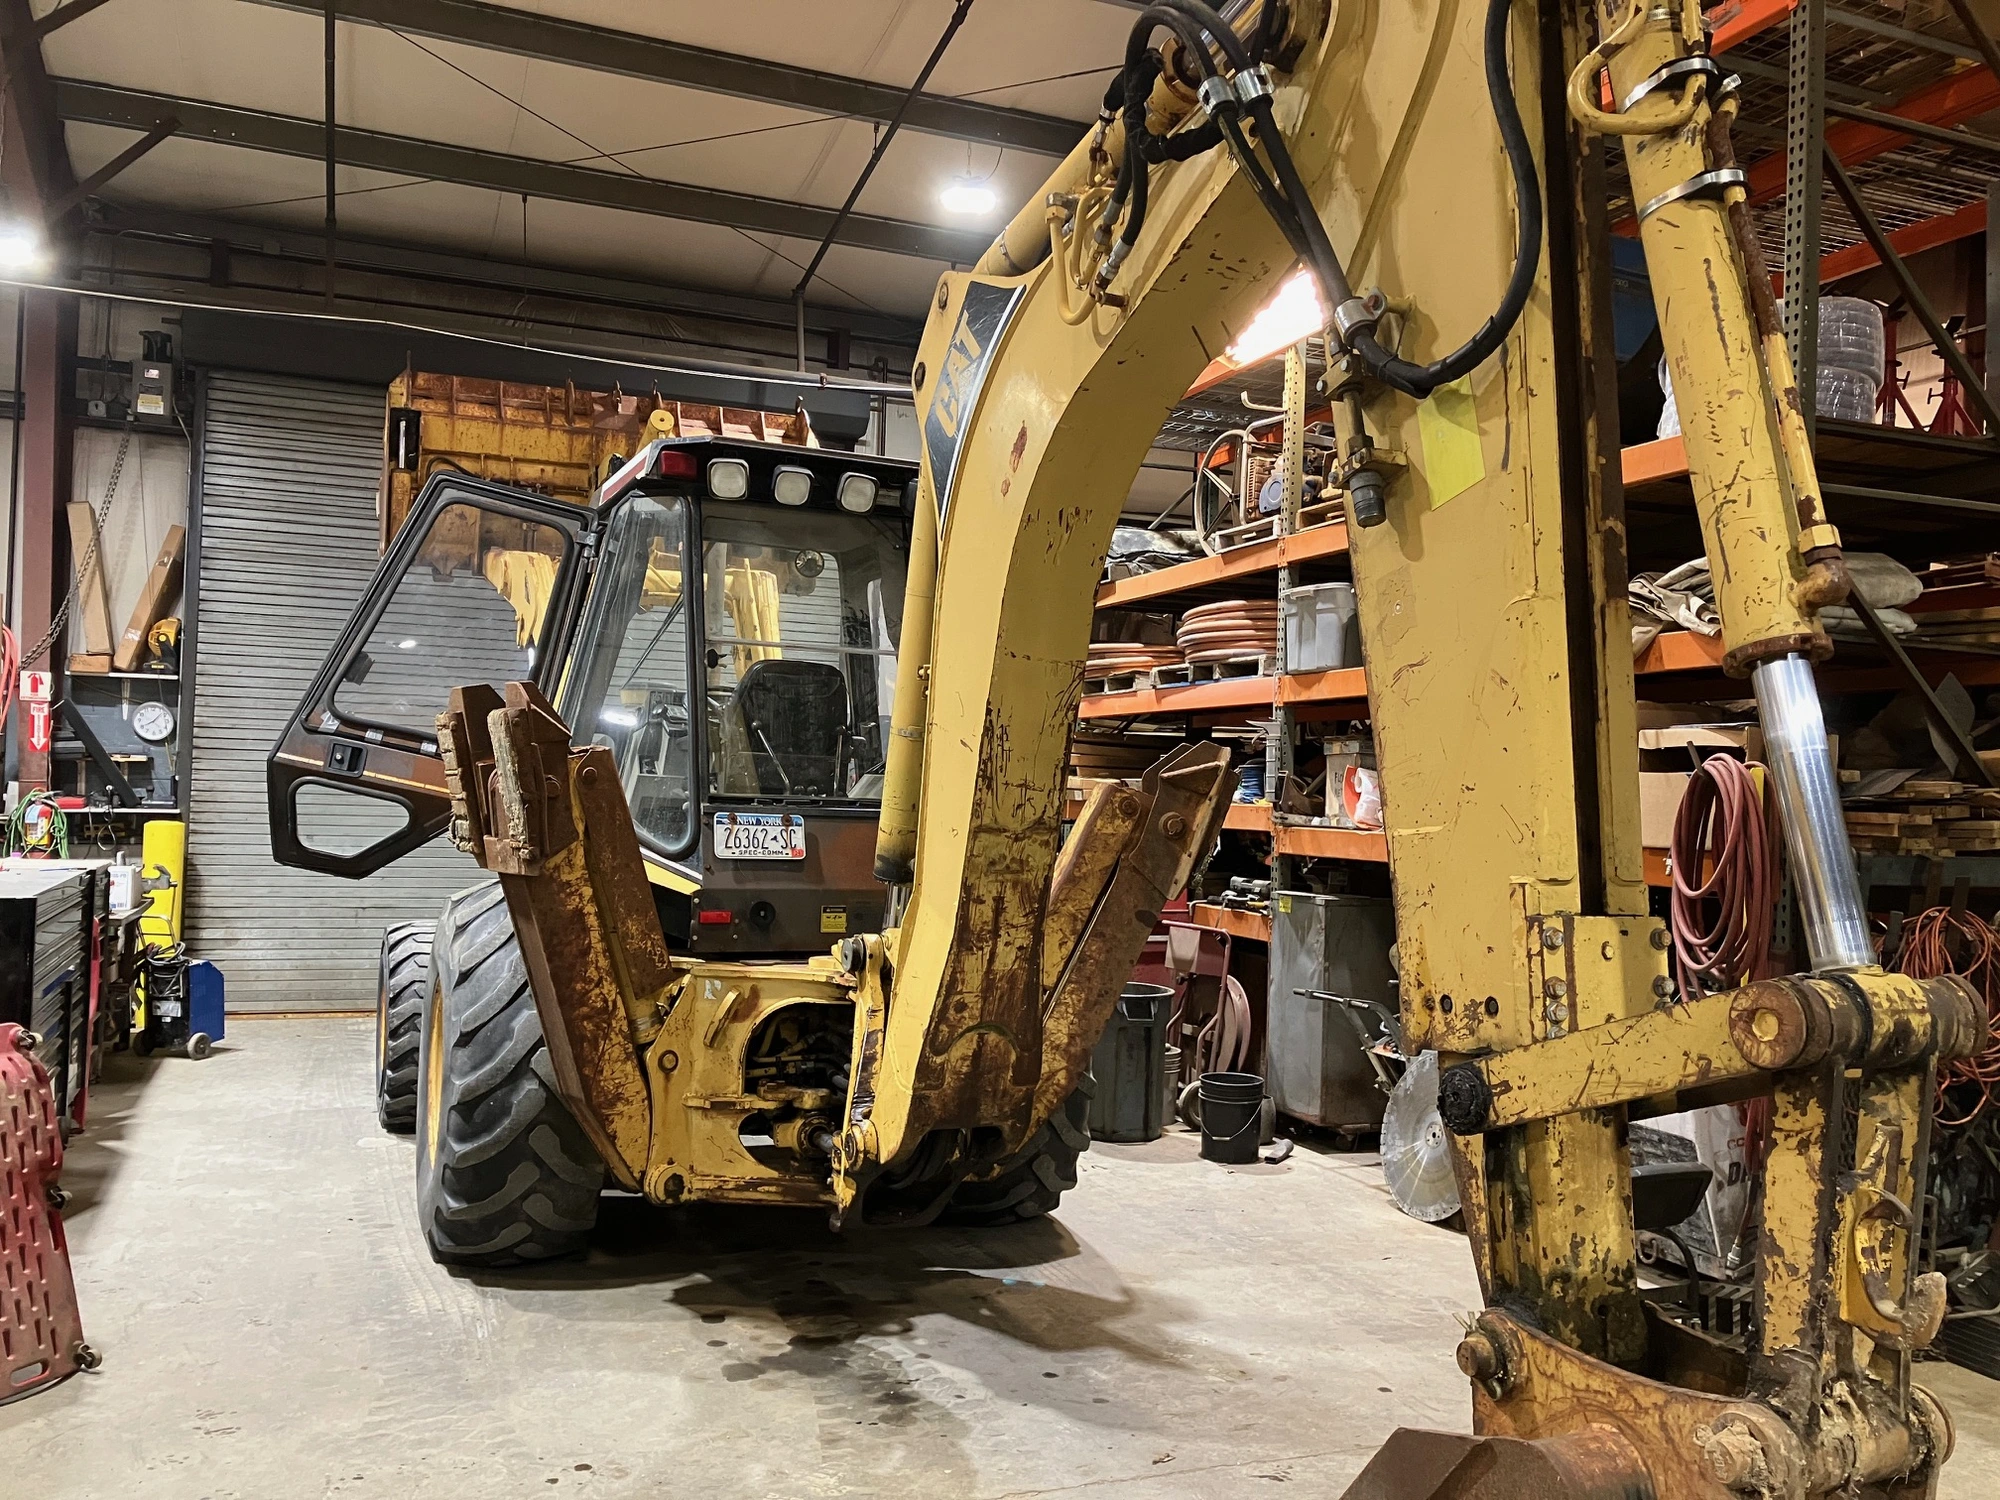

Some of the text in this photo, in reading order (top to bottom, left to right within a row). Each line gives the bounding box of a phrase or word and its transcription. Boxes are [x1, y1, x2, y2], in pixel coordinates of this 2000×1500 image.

[935, 309, 982, 438] CAT
[32, 706, 45, 714] FIRE
[737, 816, 782, 826] NEW YORK
[724, 827, 797, 849] 26362 SC
